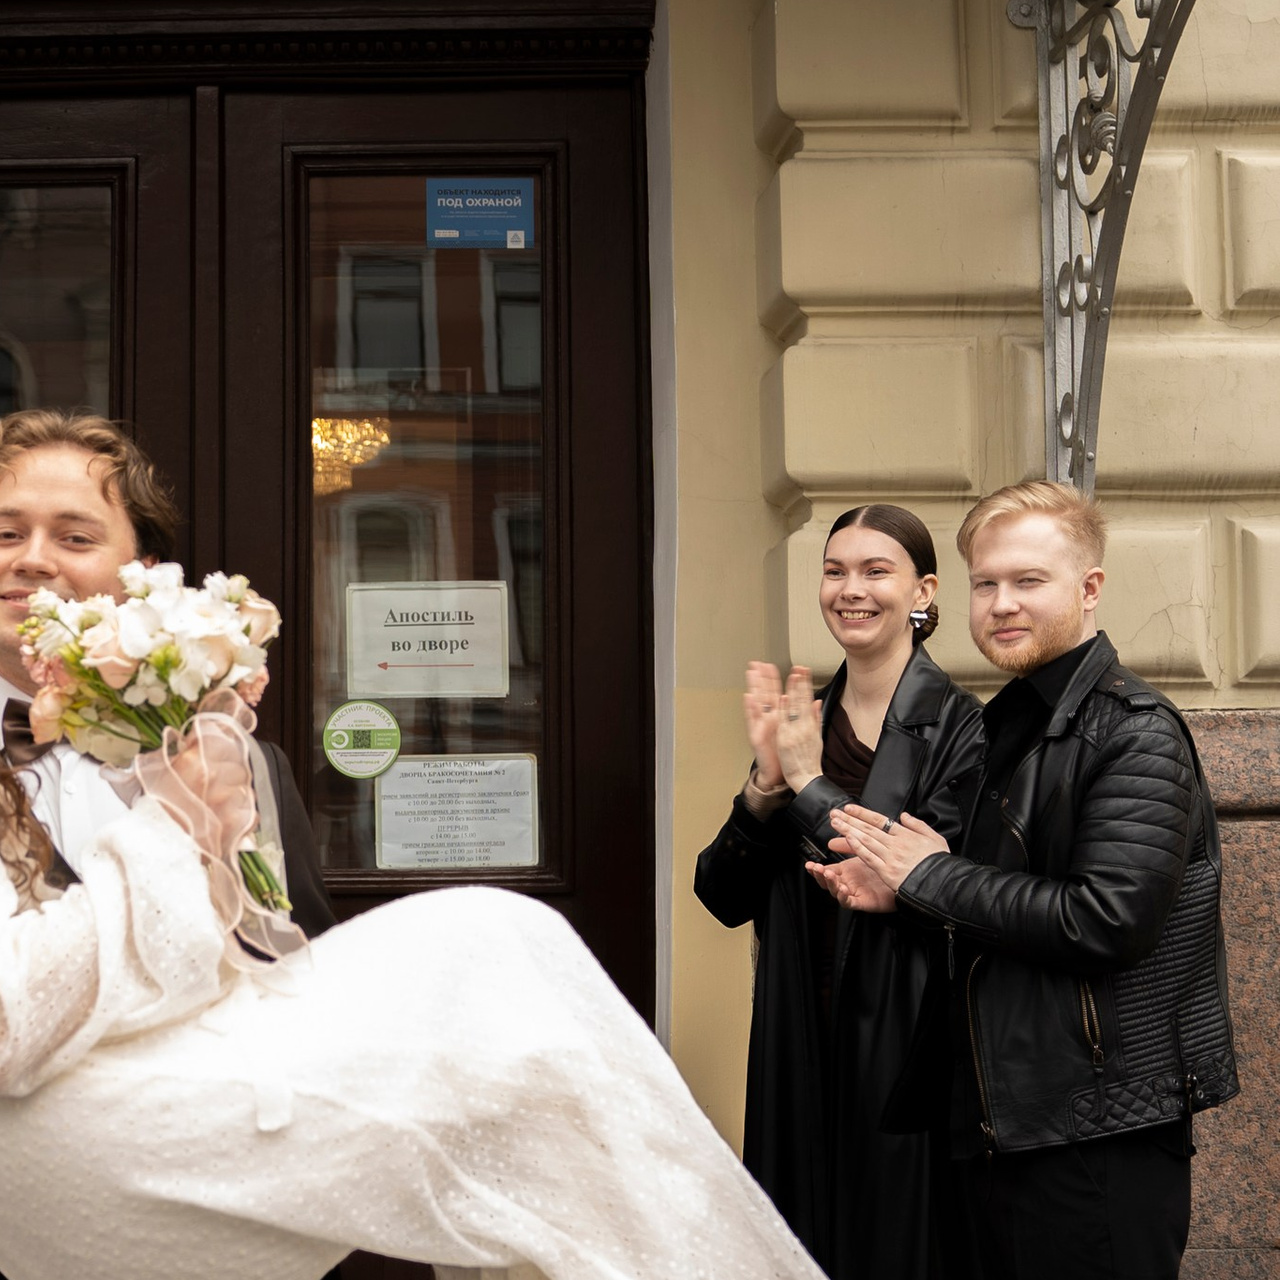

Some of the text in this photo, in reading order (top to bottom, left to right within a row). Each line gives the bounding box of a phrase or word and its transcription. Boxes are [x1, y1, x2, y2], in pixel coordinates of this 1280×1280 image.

[437, 196, 522, 208] ПОД ОХРАНОЙ
[384, 608, 474, 624] Апостиль
[391, 639, 469, 654] во дворе
[331, 705, 393, 727] УЧАСТНИК ПРОЕКТА
